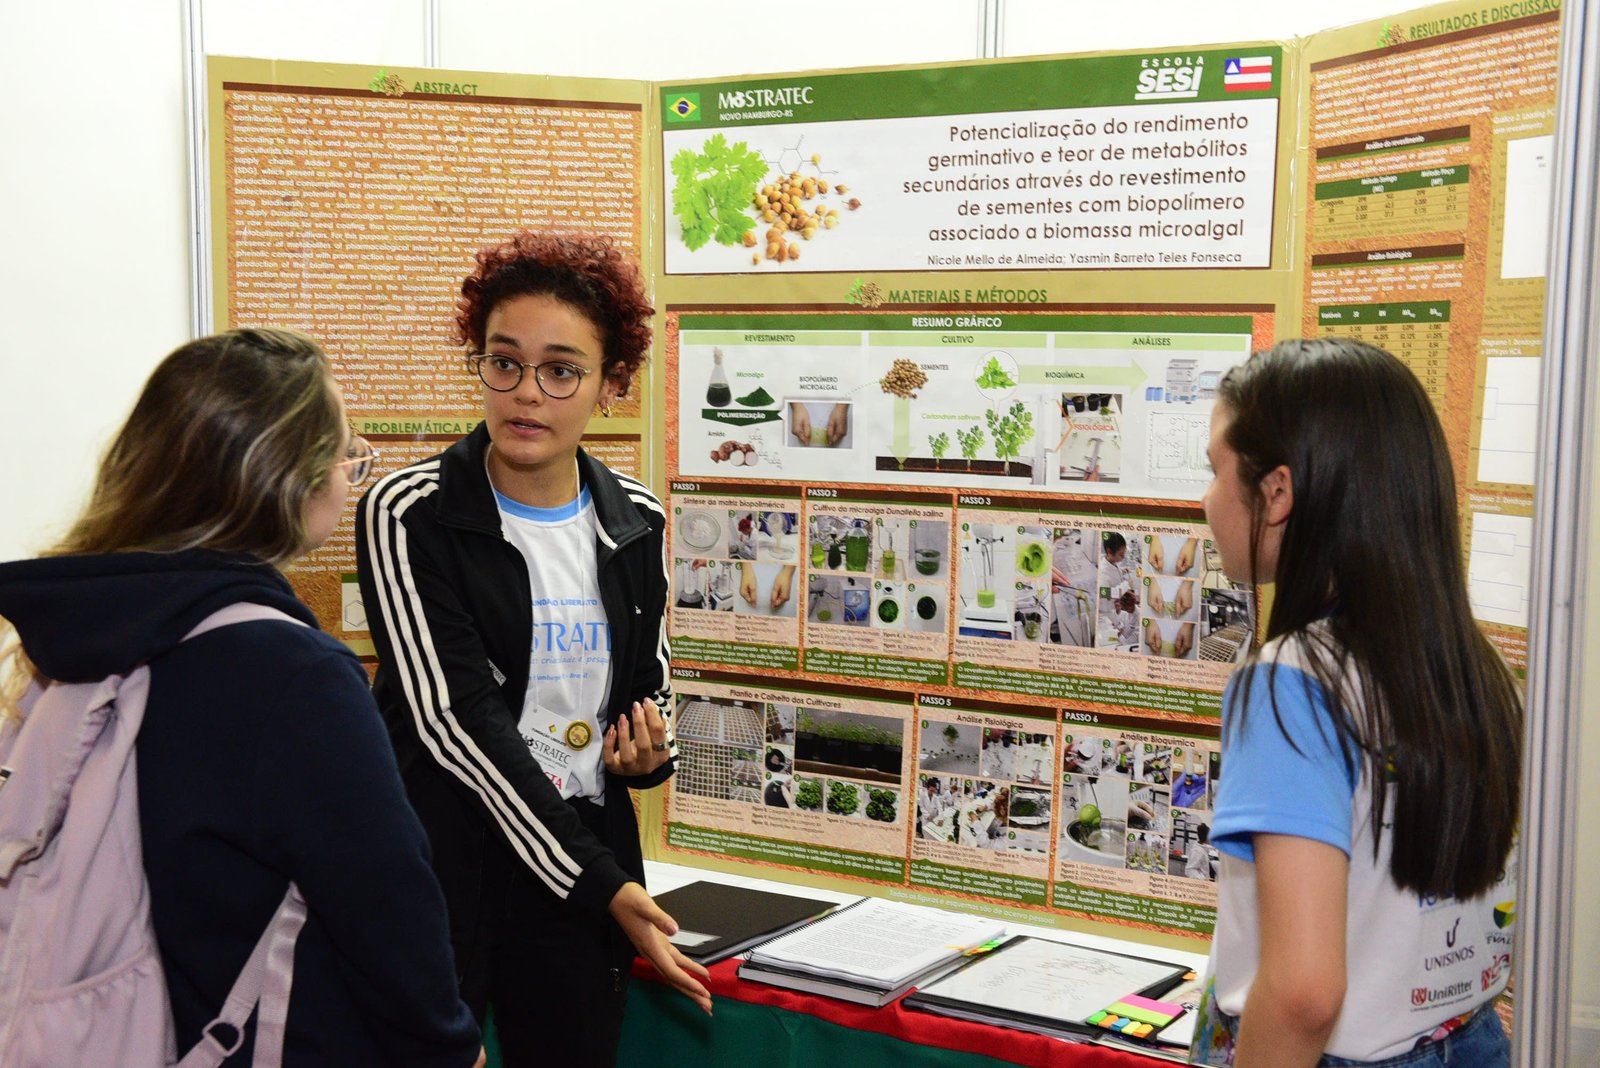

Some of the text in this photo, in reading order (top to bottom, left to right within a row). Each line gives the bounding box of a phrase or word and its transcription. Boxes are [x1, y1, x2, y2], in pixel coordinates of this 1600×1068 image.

[1410, 12, 1477, 40] RESULTADOS
[1481, 10, 1488, 23] E
[1141, 56, 1204, 68] ESCOLA
[1136, 66, 1203, 93] SESI
[413, 82, 477, 95] ABSTRACT
[718, 86, 814, 109] MOSTRATEC
[719, 109, 793, 121] NOVO HAMBURGO-RS
[950, 112, 1248, 142] Potencialização do rendimento
[928, 138, 1248, 171] germinativo e teor de metabólitos
[903, 166, 1246, 193] secundários através do revestimento
[957, 192, 1245, 216] de sementes com biopolímero
[928, 219, 1244, 241] associado a biomassa microalgal
[927, 252, 1242, 266] Nicole Mello de Almeida; Yasmin Barreto Teles Fonseca
[889, 286, 1048, 303] MATERIAIS E MÉTODOS
[912, 315, 1002, 328] RESUMO GRÁFICO
[744, 334, 796, 342] REVESTIMENTO
[942, 335, 974, 344] CULTIVO
[1132, 336, 1171, 346] ANÁLISES
[799, 375, 838, 383] BIOPOLÍMERO
[1045, 371, 1085, 380] BIOQUÍMICA
[364, 420, 473, 433] PROBLEMÁTICA E
[1073, 421, 1115, 431] FISIOLÓGICA
[673, 483, 696, 491] PASSO
[807, 488, 831, 497] PASSO
[960, 496, 984, 505] PASSO
[1038, 517, 1190, 535] Processo de revestimento das sementes
[672, 668, 700, 678] PASSO 4
[730, 689, 752, 698] Plantio
[761, 692, 790, 703] Colheita
[791, 696, 804, 704] das
[806, 697, 842, 709] Cultivares
[920, 696, 952, 706] PASSO 5
[957, 715, 1023, 729] Análise Fisiológica
[1065, 711, 1098, 723] PASSO 6
[1120, 732, 1196, 748] Análise Bioquímica
[1425, 945, 1475, 971] UNISINOS
[1428, 981, 1472, 1002] UniRitter
